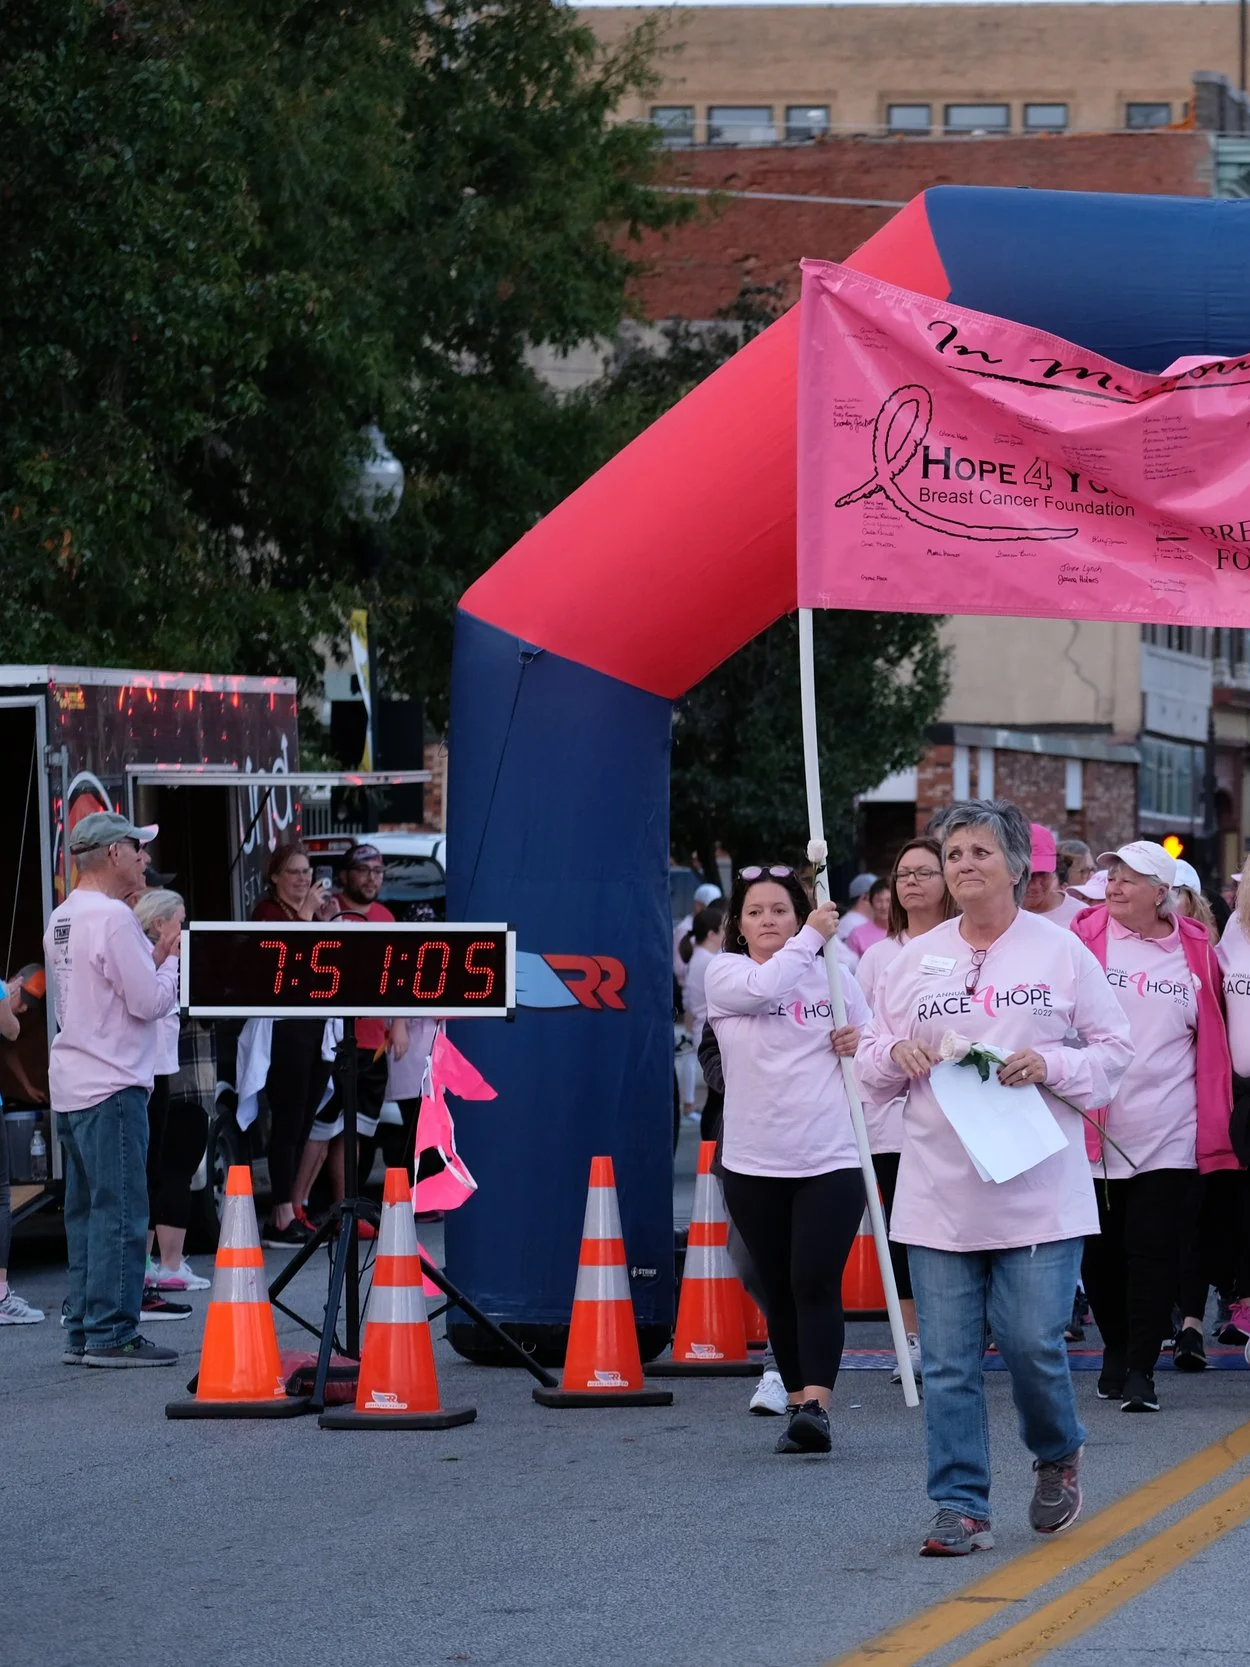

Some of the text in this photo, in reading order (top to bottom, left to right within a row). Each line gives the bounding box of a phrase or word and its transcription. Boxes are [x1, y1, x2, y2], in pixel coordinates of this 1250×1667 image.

[927, 320, 1003, 364] In
[921, 445, 1017, 485] HOPE
[1023, 456, 1053, 491] 4
[919, 487, 1136, 517] Breast Cancer Foundation
[541, 954, 627, 1009] RR
[1106, 967, 1129, 976] NNUAL
[1106, 971, 1190, 1002] CE 4 HOPE
[803, 1003, 834, 1019] HO
[917, 985, 1054, 1023] RACE 4 HOPE
[1032, 1007, 1053, 1017] 2022
[1173, 997, 1190, 1008] 2022
